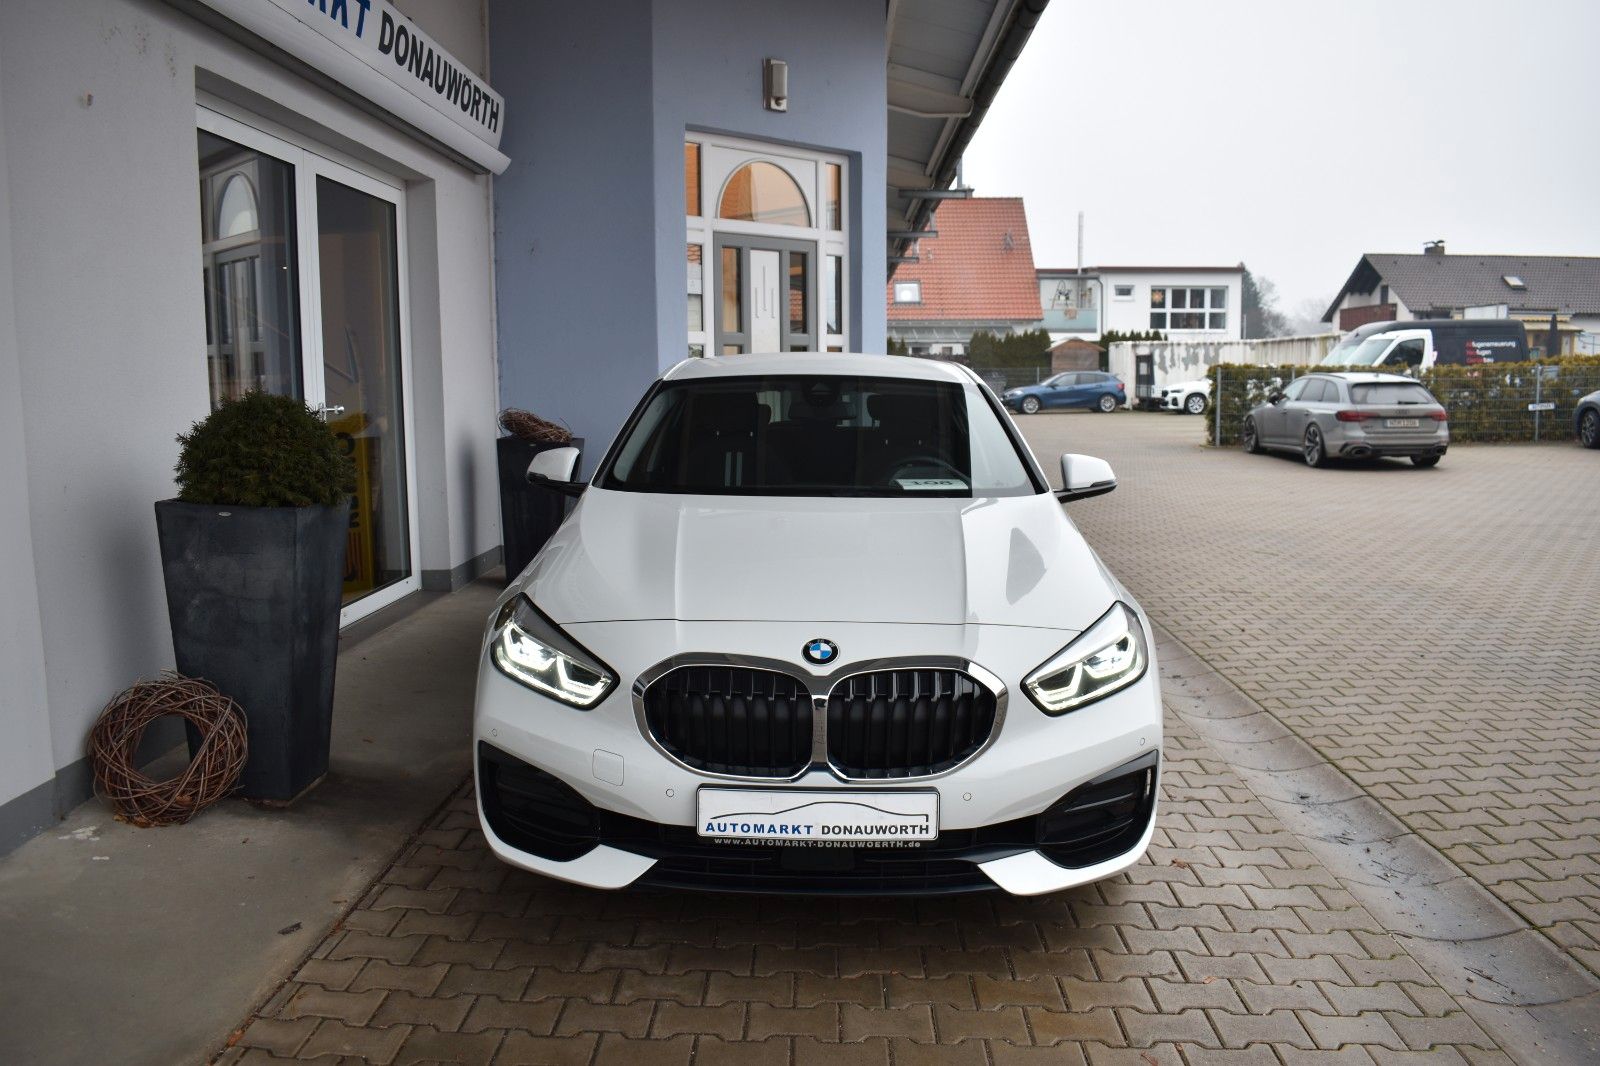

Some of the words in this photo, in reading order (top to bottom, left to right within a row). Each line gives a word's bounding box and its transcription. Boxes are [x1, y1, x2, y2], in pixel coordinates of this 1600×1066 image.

[378, 10, 499, 133] DONAUWÖRTH
[705, 822, 813, 835] AUTOMARKT
[714, 838, 920, 848] www.AUTOMARKT-DONAUWOERTH.de
